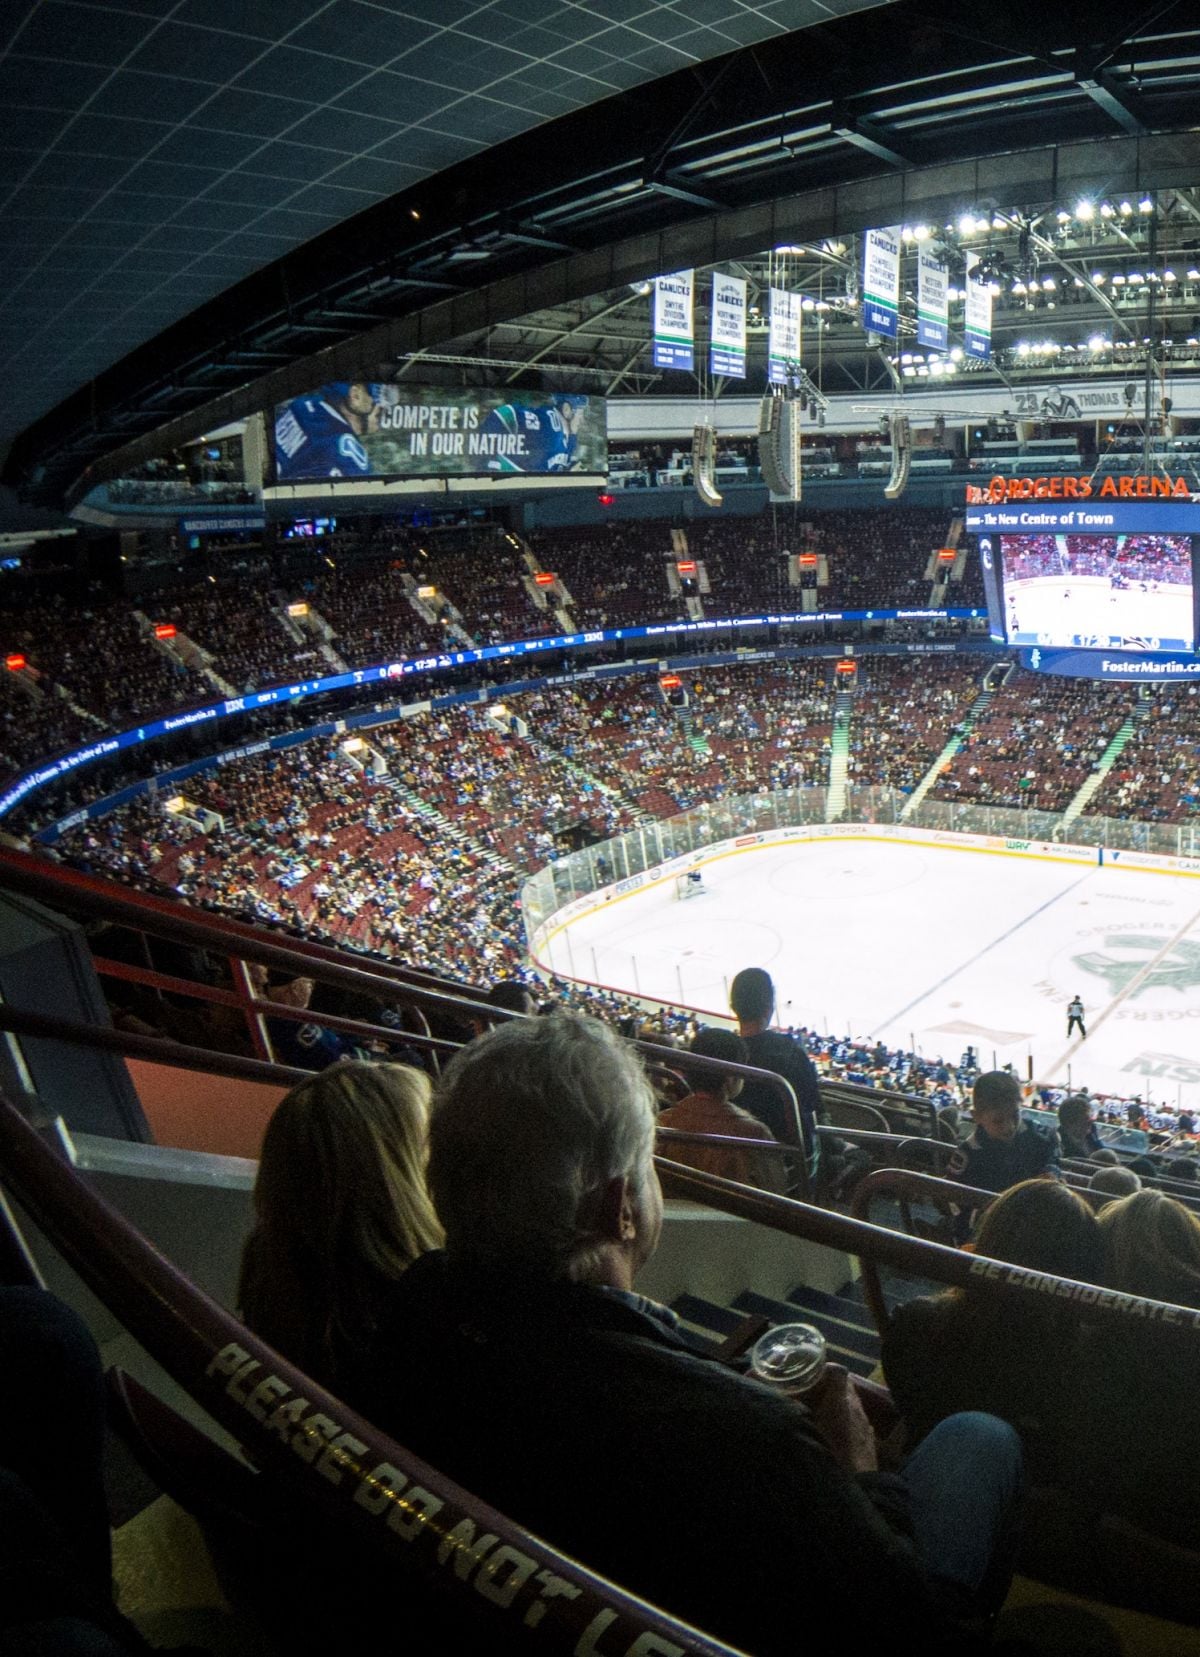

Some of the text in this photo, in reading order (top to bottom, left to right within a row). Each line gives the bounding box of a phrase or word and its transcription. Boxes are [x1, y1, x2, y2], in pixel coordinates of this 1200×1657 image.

[870, 233, 898, 255] CANUCKS
[659, 281, 690, 296] CANUCKS
[717, 293, 743, 307] CANUCKS
[1015, 393, 1039, 412] 23
[1077, 392, 1120, 408] THOMAS
[381, 405, 480, 431] COMPETE IS
[410, 433, 530, 456] IN OUR NATURE.
[1009, 477, 1092, 498] ROGERS
[1101, 476, 1189, 497] ARENA
[985, 512, 1114, 525] The New Centre of Town
[897, 610, 948, 618] FosterMartin.ca
[646, 627, 666, 635] Foster
[666, 624, 687, 632] Martin
[696, 621, 716, 629] White
[716, 619, 733, 627] Rock
[732, 618, 763, 627] Commons
[767, 615, 780, 623] The
[795, 614, 816, 622] Centre
[834, 826, 868, 834] TOYOTA
[1091, 921, 1180, 936] ROGERS
[968, 1258, 1002, 1282] BE
[204, 1341, 583, 1629] PLEASE DO NOT
